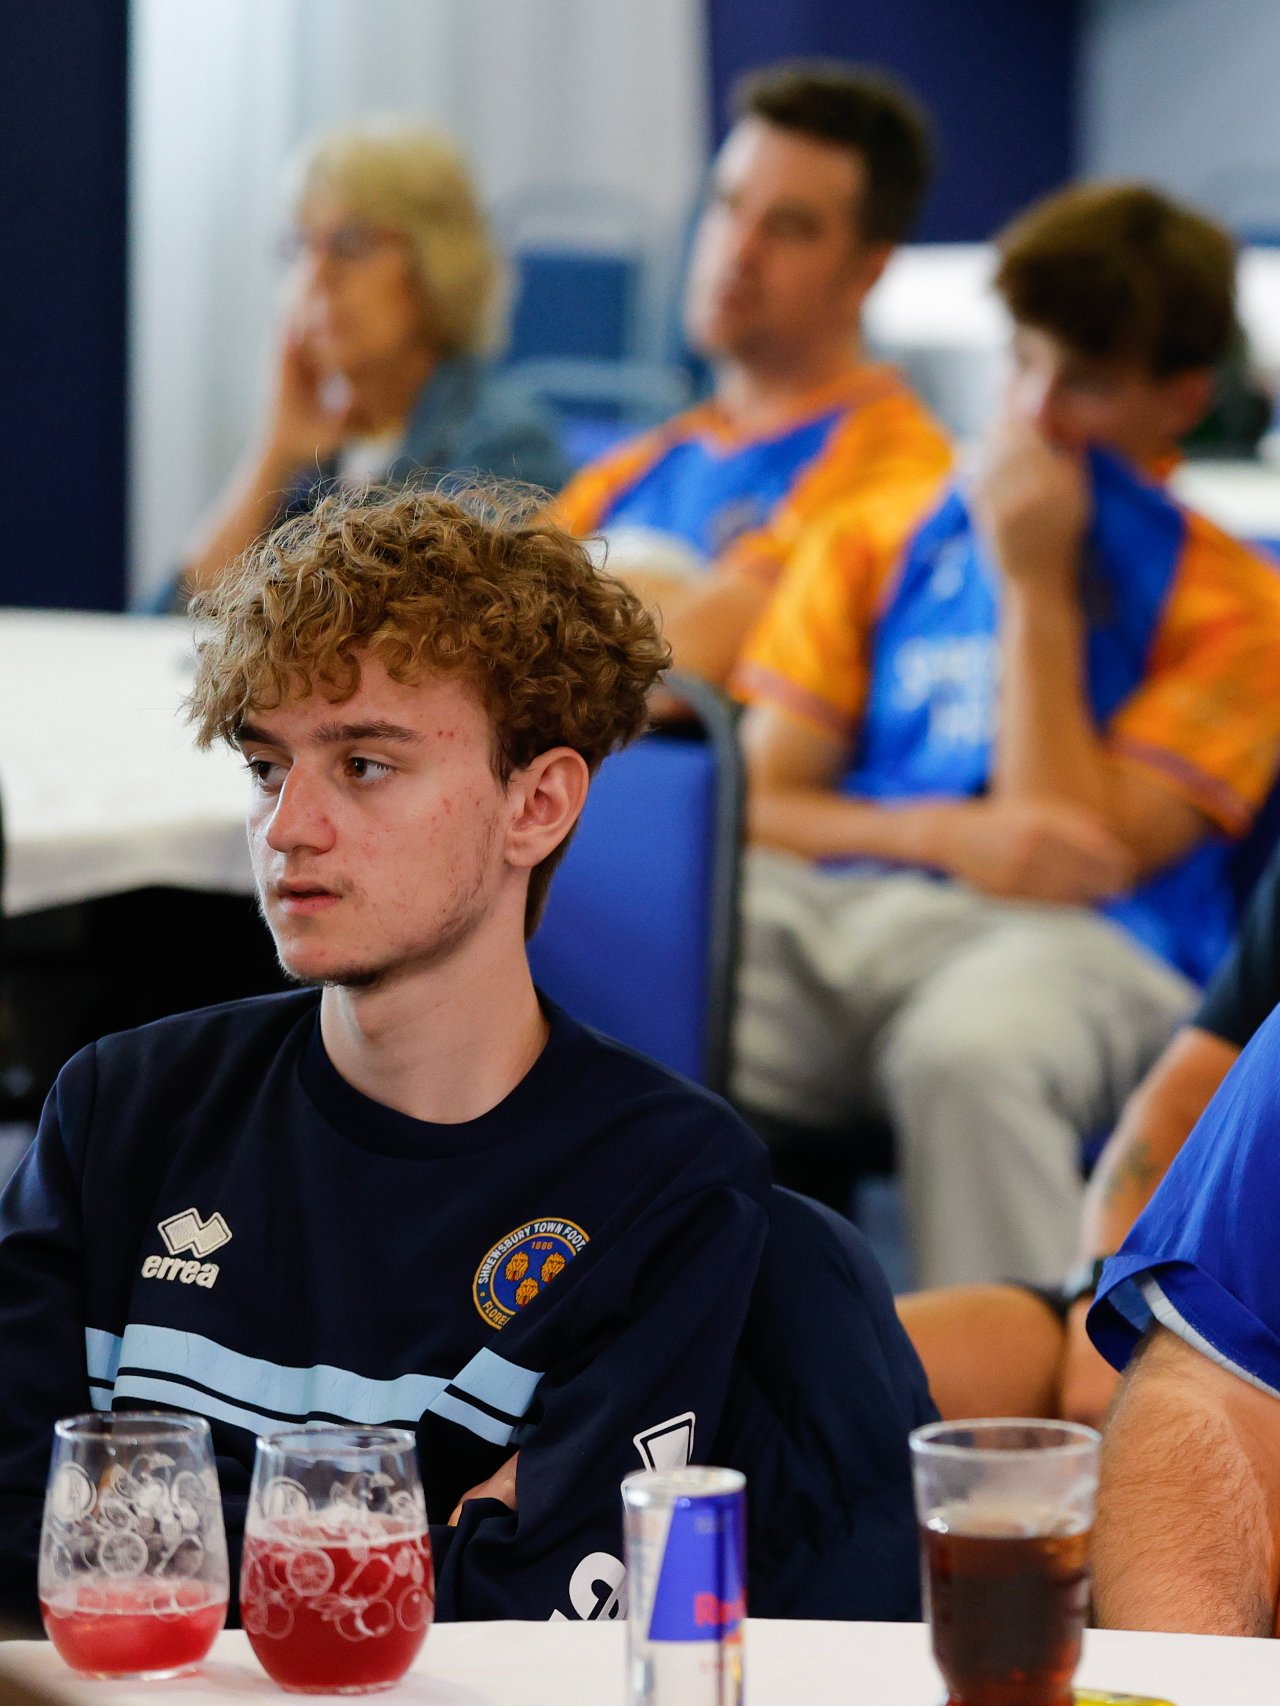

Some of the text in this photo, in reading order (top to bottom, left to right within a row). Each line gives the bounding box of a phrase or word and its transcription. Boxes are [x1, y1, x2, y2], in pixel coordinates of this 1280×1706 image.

[478, 1221, 588, 1285] SHREWSBURY TOWN FOOT
[482, 1300, 511, 1326] FLORE
